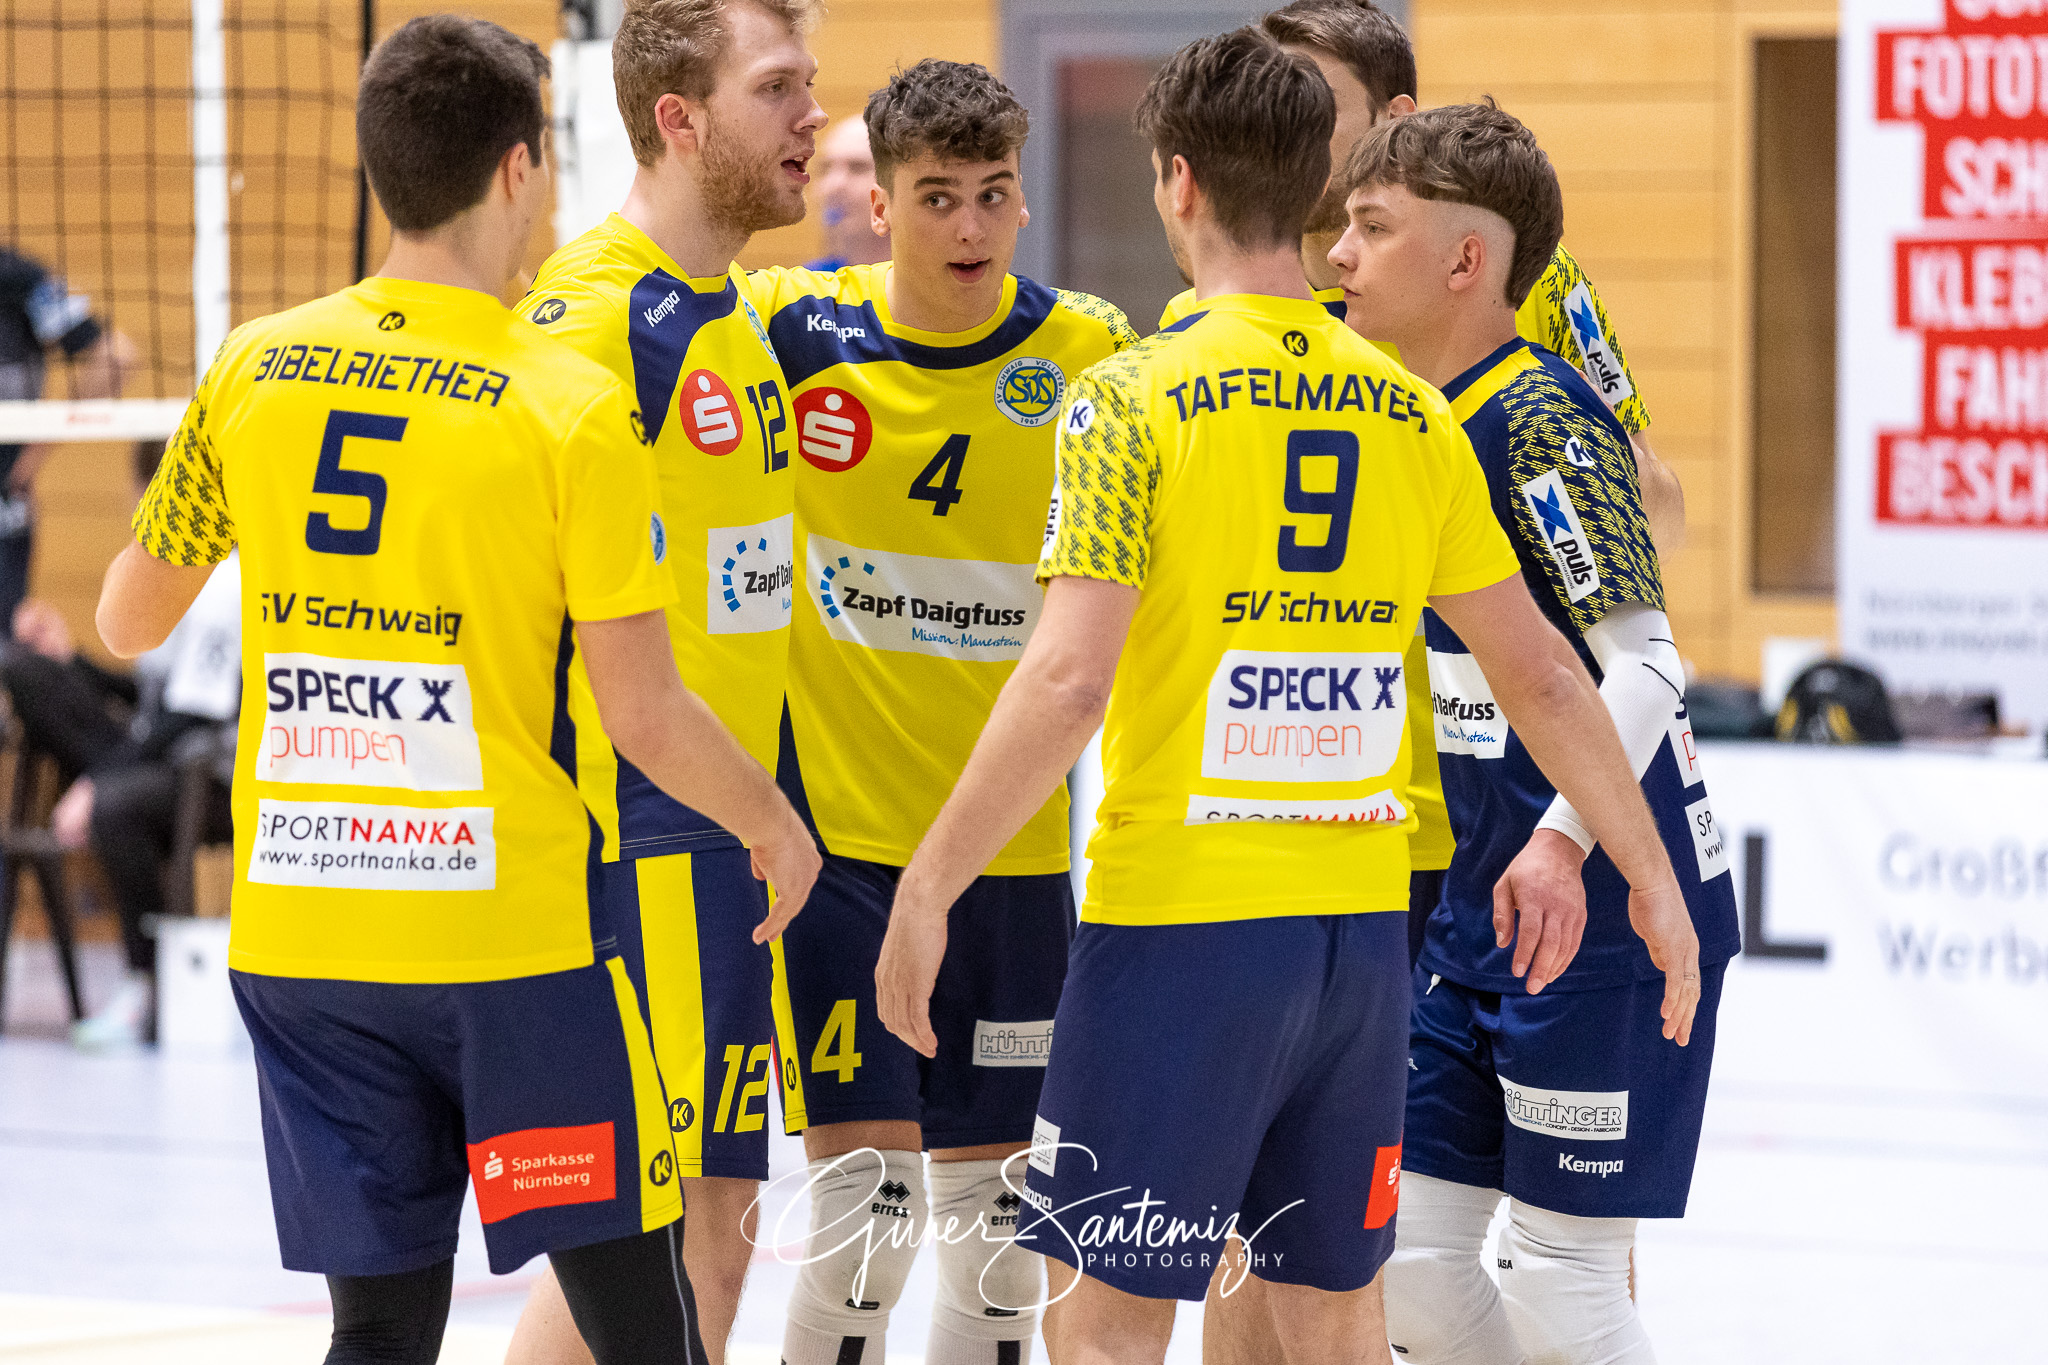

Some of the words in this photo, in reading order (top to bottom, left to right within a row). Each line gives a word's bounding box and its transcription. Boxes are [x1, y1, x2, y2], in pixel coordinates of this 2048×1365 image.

[643, 290, 681, 328] Kempa
[254, 345, 510, 407] BIBELRIETHER
[1587, 351, 1621, 394] puls
[1937, 346, 2048, 427] FAH
[745, 379, 789, 475] 12
[1020, 417, 1039, 425] 1967
[304, 409, 409, 556] 5
[908, 433, 972, 517] 4
[1277, 429, 1361, 573] 9
[743, 564, 780, 597] Zapf
[1553, 538, 1594, 585] puls
[306, 595, 463, 646] Schwaig
[843, 586, 906, 619] Zapf
[911, 597, 1026, 630] Daigfuss
[1222, 590, 1274, 624] SV
[267, 667, 405, 721] SPECK
[1228, 664, 1363, 712] SPECK
[270, 725, 406, 771] pumpen
[1223, 721, 1363, 768] pumpen
[259, 848, 478, 874] www.sportnanka.de
[1876, 920, 2048, 988] Werb
[811, 998, 863, 1084] 4
[712, 1043, 771, 1134] 12
[511, 1151, 596, 1172] Sparkasse
[513, 1171, 590, 1192] Nürnberg
[1558, 1152, 1624, 1179] Kempa
[991, 1214, 1019, 1226] erre
